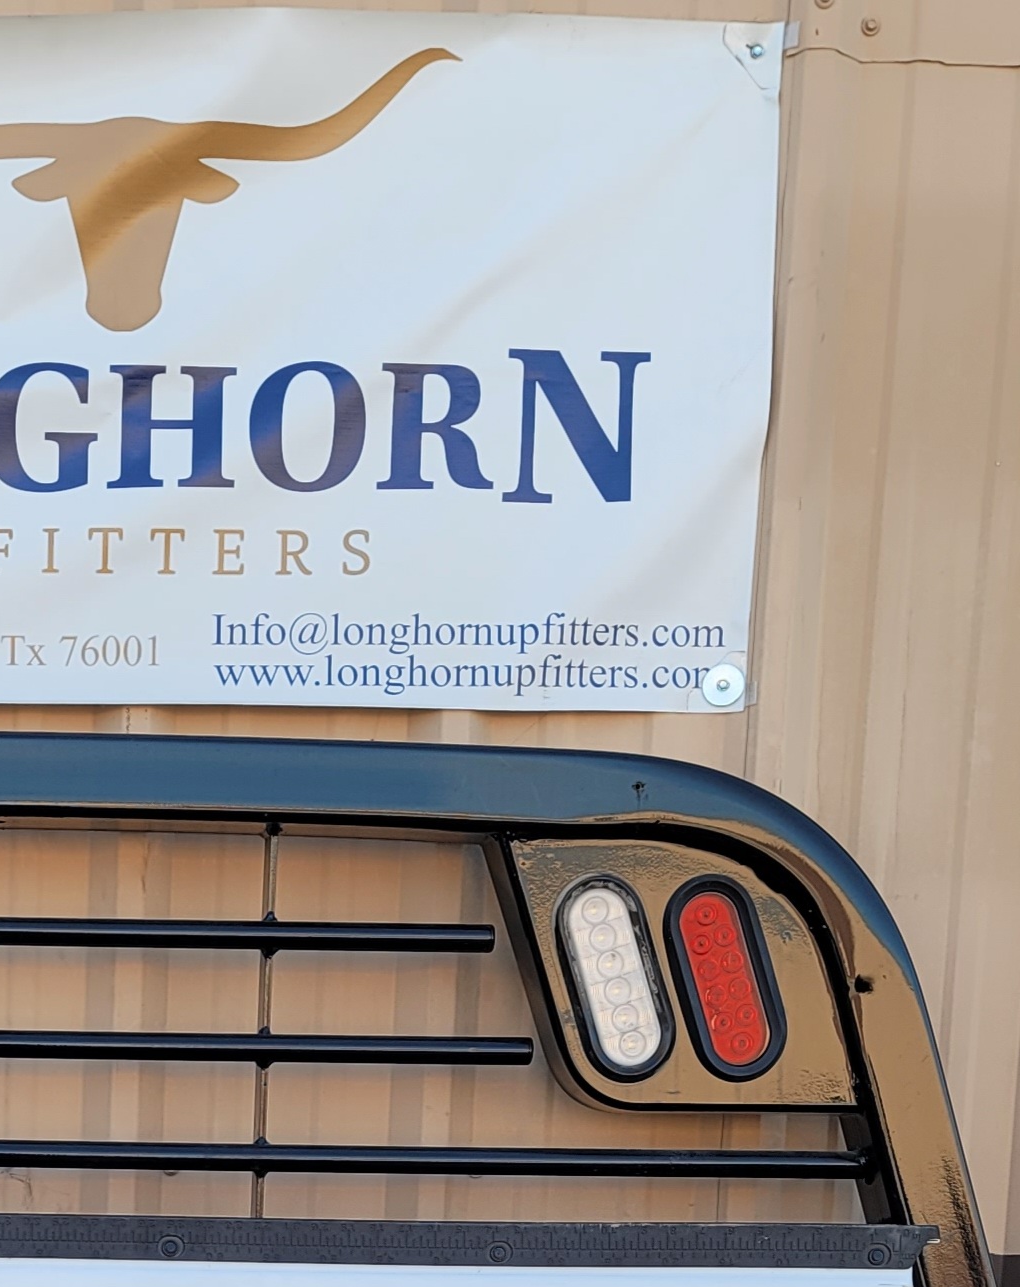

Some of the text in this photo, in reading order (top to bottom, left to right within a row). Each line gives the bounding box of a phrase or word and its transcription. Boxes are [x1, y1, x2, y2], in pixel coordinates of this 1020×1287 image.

[0, 634, 48, 667] Tx
[59, 634, 161, 668] 76001
[211, 612, 726, 655] Info@longhornupfitters.com
